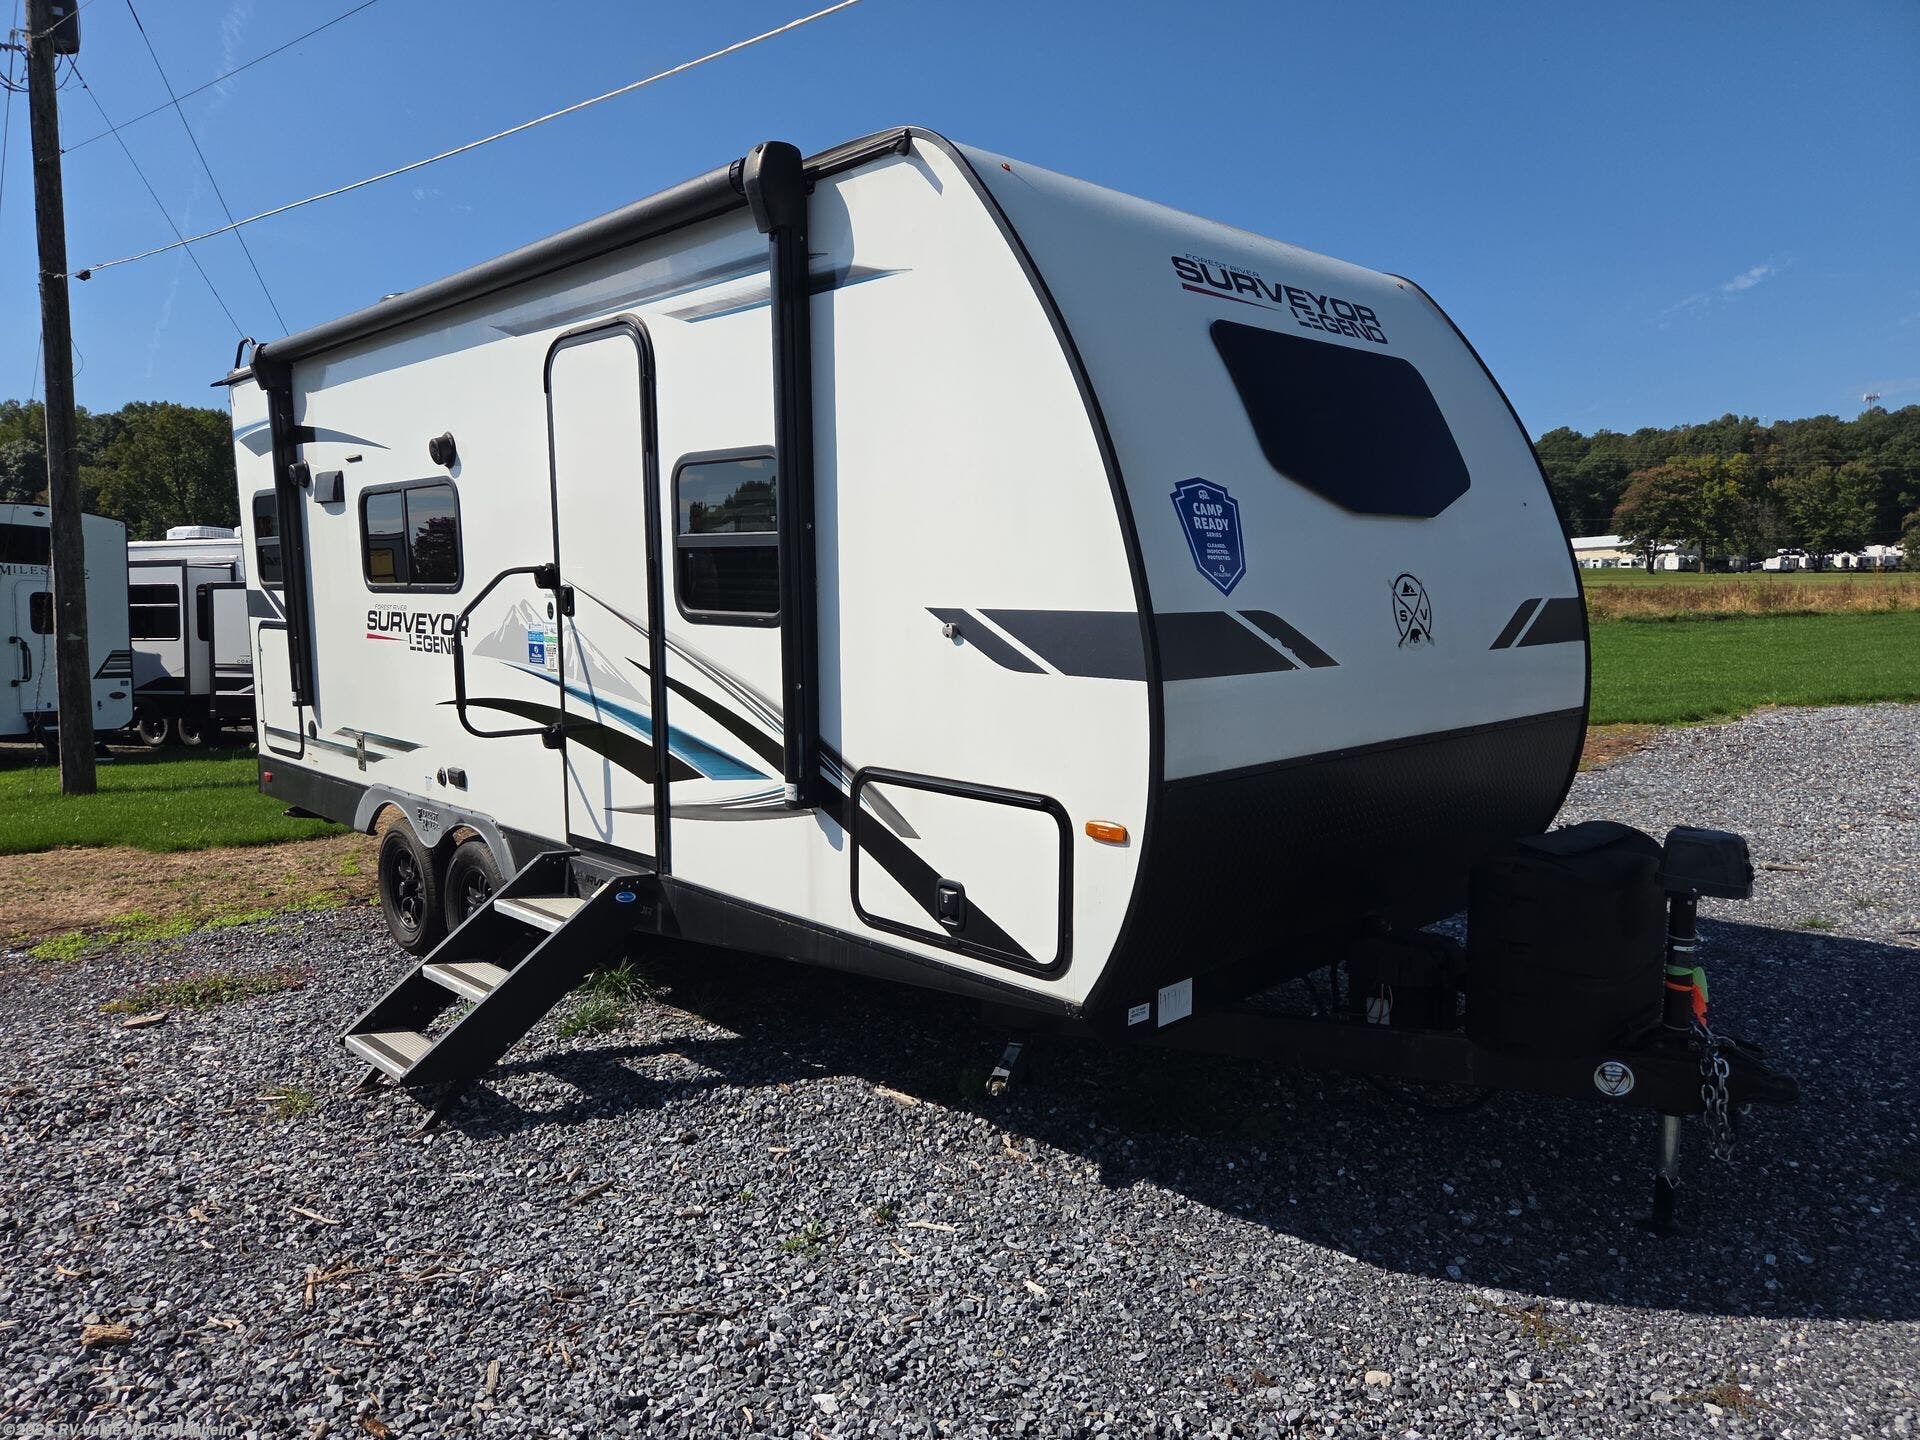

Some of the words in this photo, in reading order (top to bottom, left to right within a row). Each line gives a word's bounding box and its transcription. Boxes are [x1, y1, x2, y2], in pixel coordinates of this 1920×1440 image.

[1185, 253, 1228, 270] FOREST
[1230, 265, 1260, 278] RIVER
[1170, 255, 1382, 328] SURVEYOR
[1289, 306, 1389, 345] LEGEND
[1193, 502, 1223, 517] CAMP
[1193, 516, 1229, 531] READY
